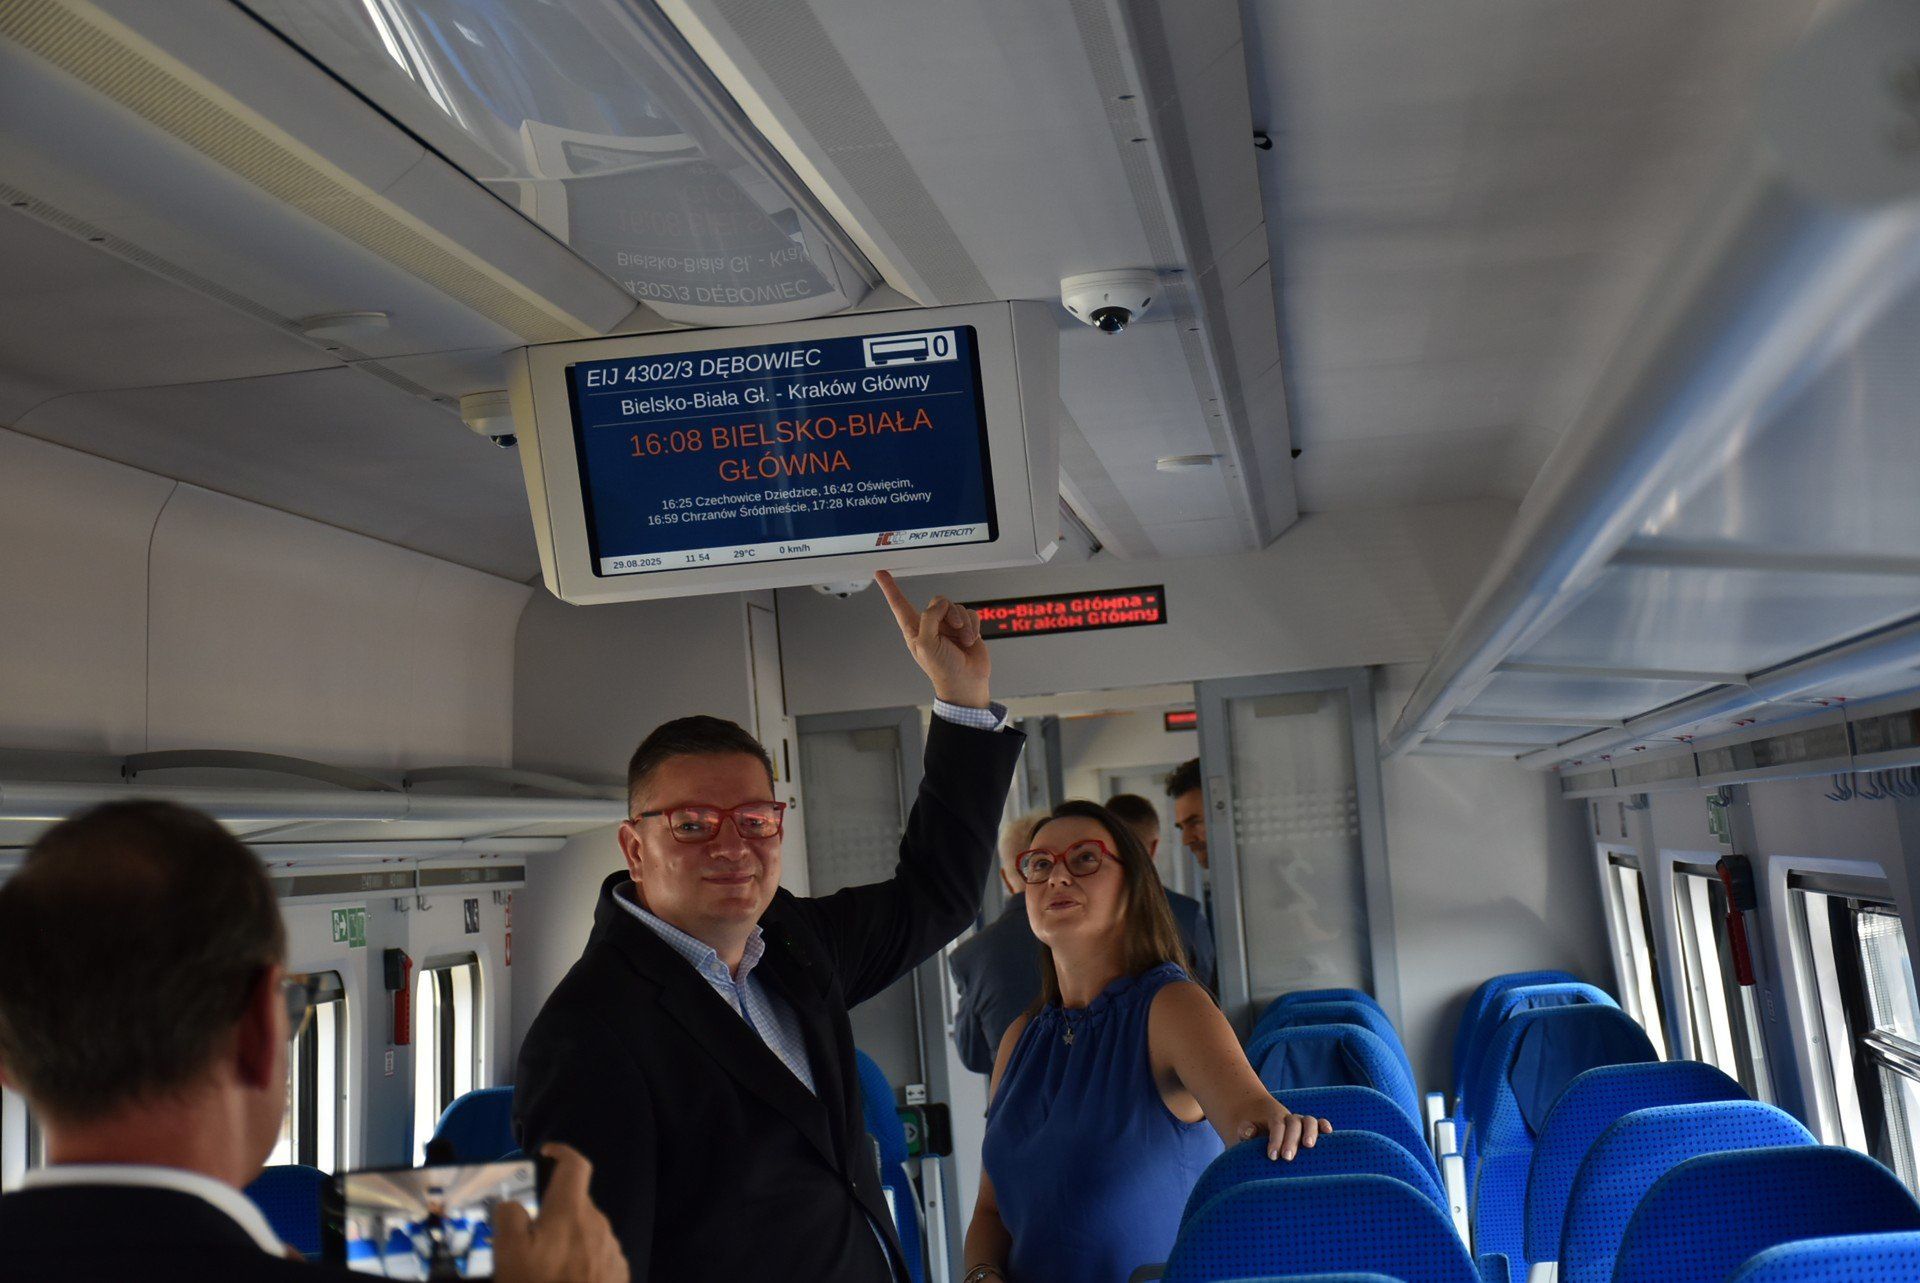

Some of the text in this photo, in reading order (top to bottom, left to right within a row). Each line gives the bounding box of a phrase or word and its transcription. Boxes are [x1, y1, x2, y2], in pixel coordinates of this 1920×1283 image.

[932, 335, 949, 357] 0
[586, 348, 822, 387] EIJ 4302/3 DĘBOWIEC
[621, 389, 740, 415] Bielsko-Biała
[744, 385, 771, 404] Gł.
[788, 379, 856, 400] Kraków
[862, 372, 931, 394] Główny
[630, 408, 933, 457] 16:08 BIELSKO-BIAŁA
[718, 449, 851, 482] GŁÓWNA
[648, 491, 932, 526] 16:59 Chrzanów Śródmieście, 17:28 Kraków Główny
[662, 478, 914, 510] 16:25 Czechowice Dziedzice, 16:42 Oświęcim,
[909, 531, 928, 540] PKP
[930, 527, 976, 539] INTERCITY
[613, 558, 662, 569] 29.08.2025
[779, 546, 785, 554] 0
[787, 543, 811, 554] km/h
[976, 602, 1067, 620] sko-Biała
[1011, 614, 1083, 632] Kraków
[1087, 606, 1160, 625] Główny
